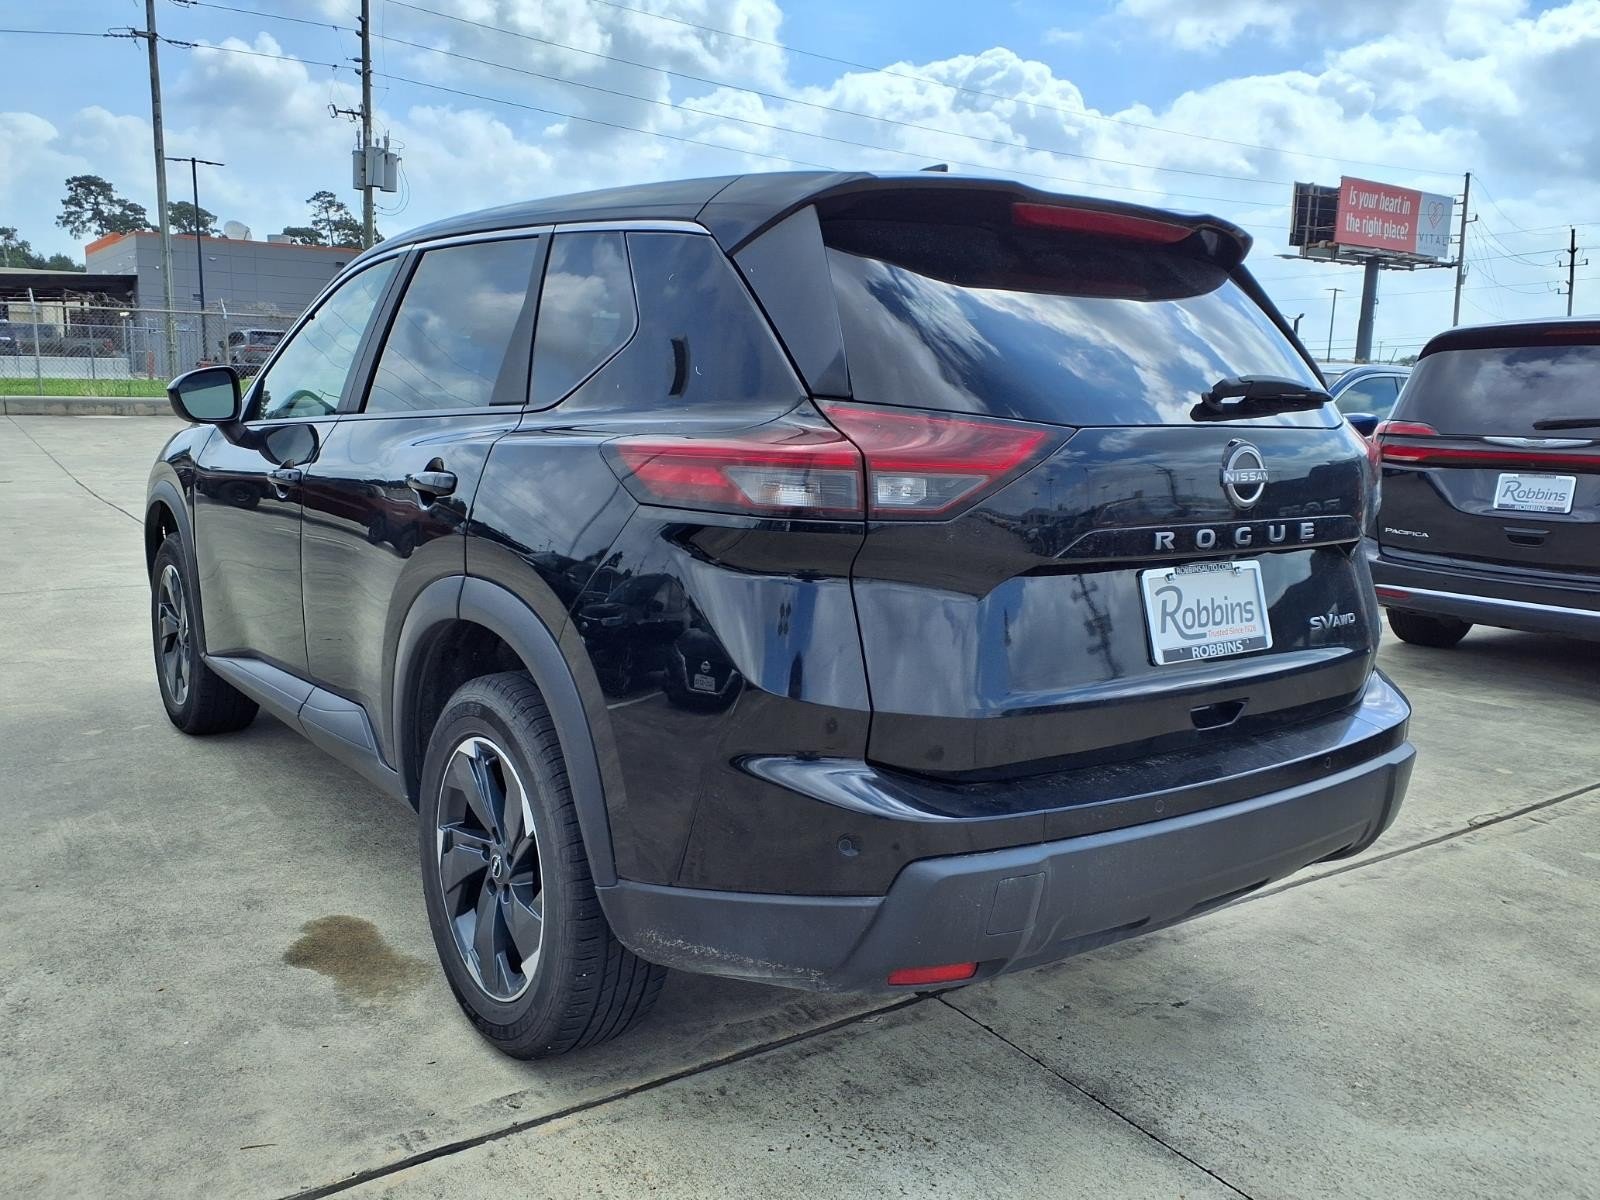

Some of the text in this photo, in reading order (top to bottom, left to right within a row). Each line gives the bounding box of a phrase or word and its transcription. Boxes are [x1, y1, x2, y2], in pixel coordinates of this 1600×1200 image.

[1348, 186, 1411, 216] Is your heart in
[1345, 213, 1409, 240] the right place?
[1224, 470, 1269, 483] NISSAN
[1502, 480, 1568, 504] Robbins
[1154, 522, 1315, 551] ROGUE
[1384, 526, 1430, 539] PACIFICA
[1154, 585, 1255, 641] Robbins
[1208, 628, 1229, 638] Trusted
[1192, 640, 1244, 659] ROBBINS
